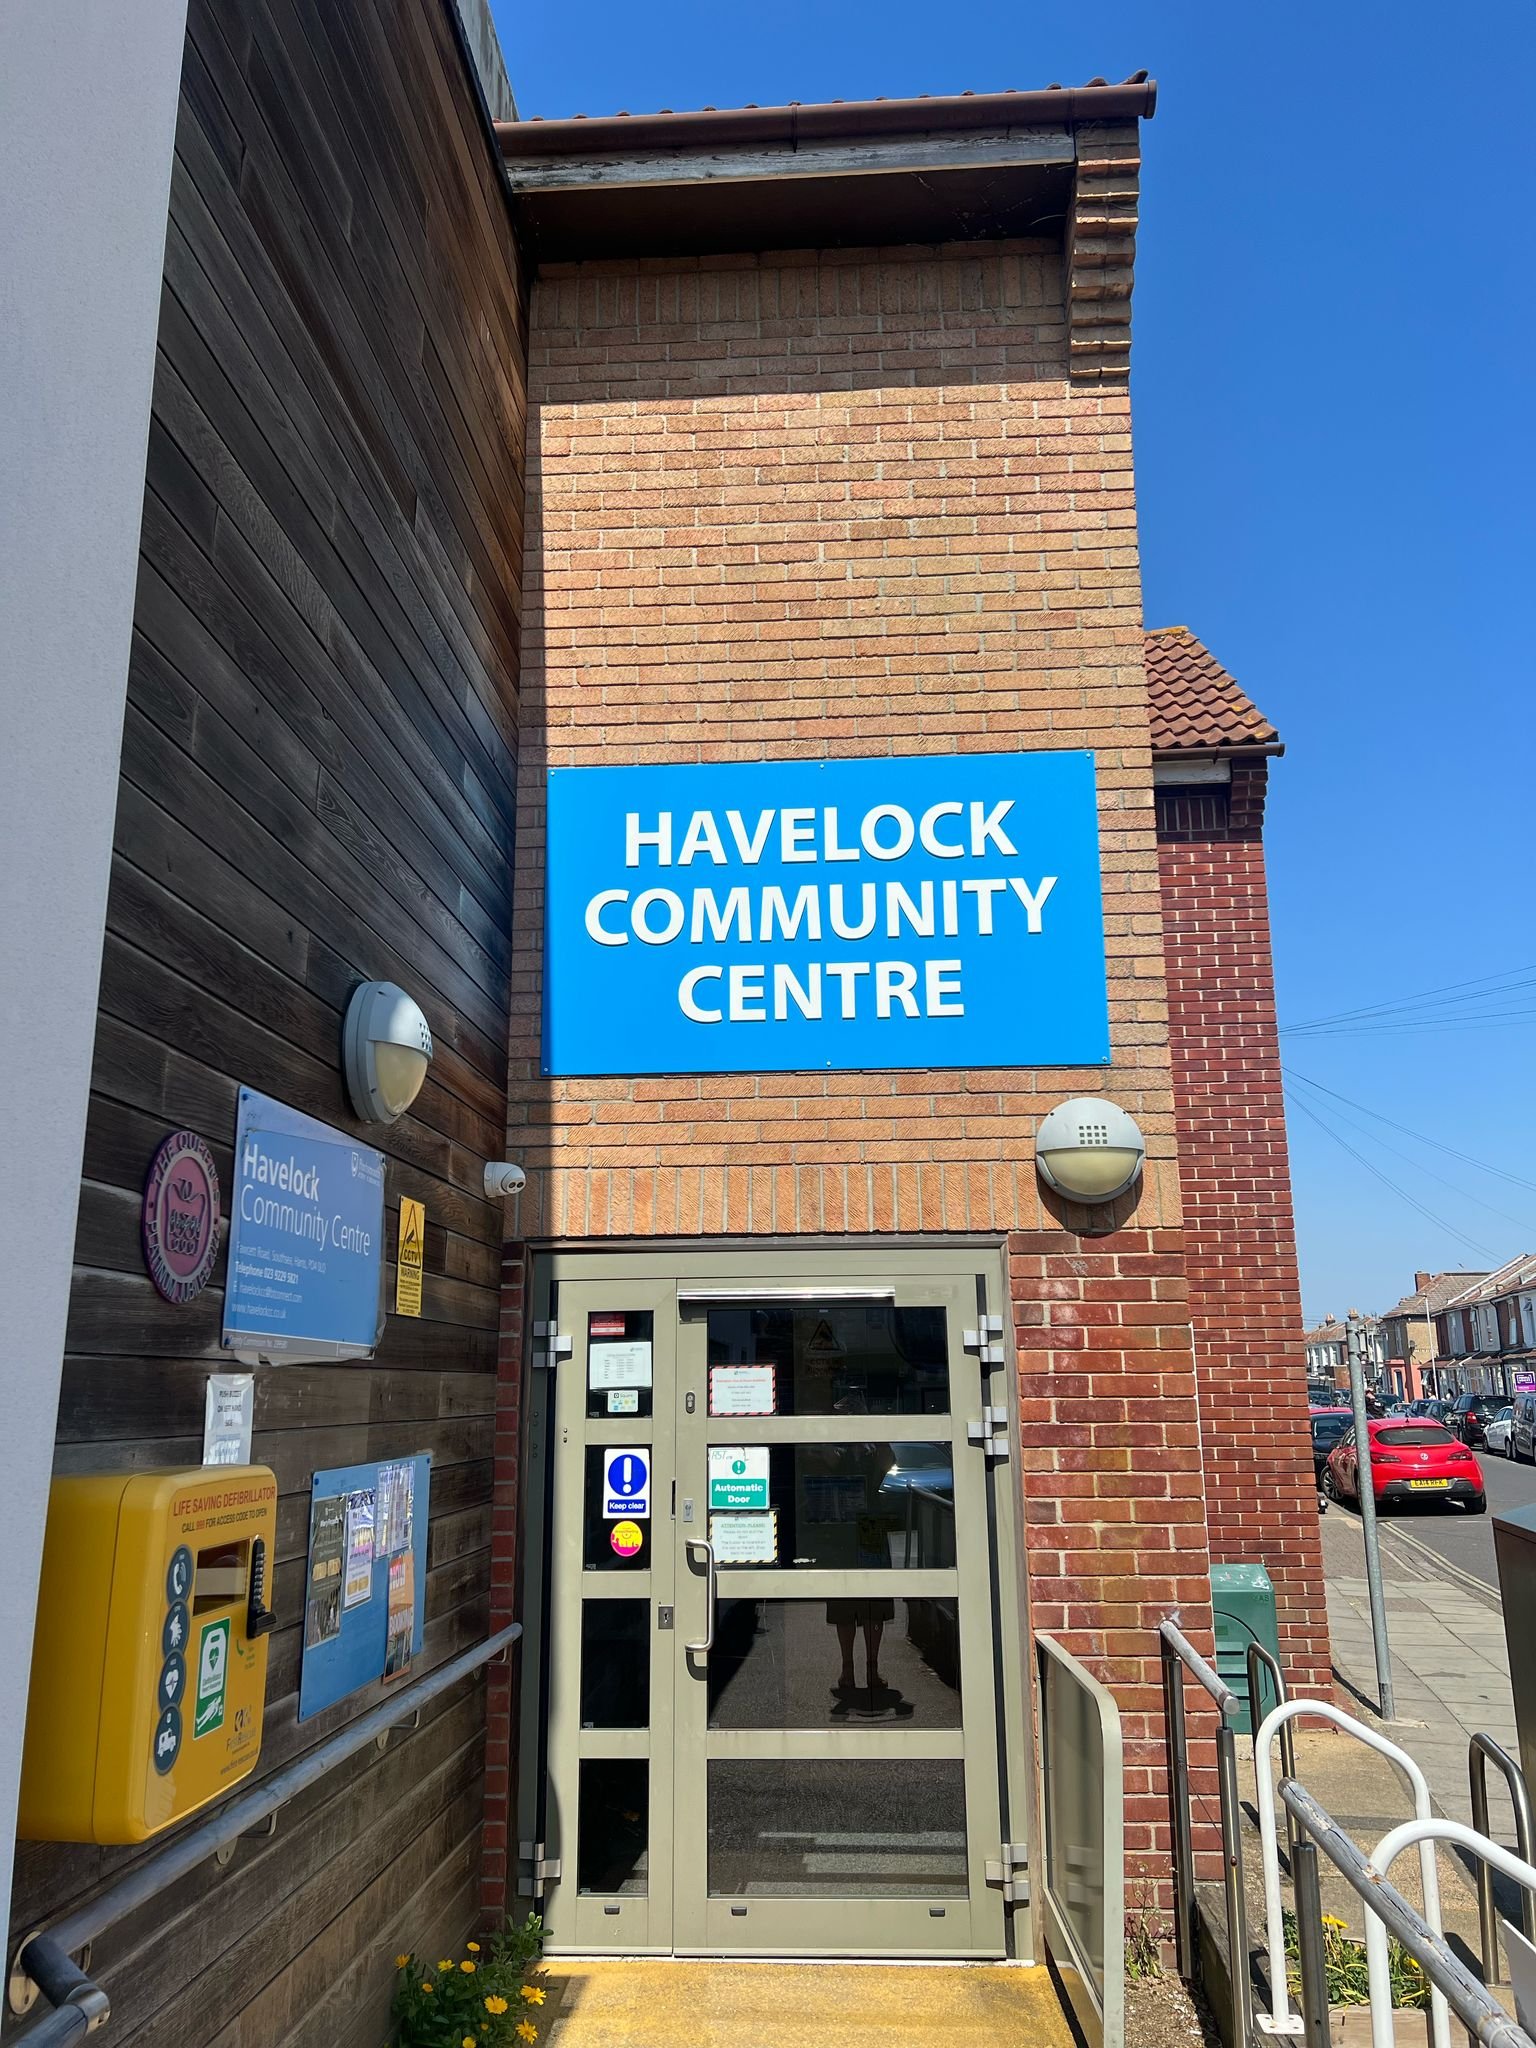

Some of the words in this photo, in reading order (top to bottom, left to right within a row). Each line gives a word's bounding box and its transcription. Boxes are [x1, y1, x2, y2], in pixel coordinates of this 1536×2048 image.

[624, 800, 1018, 867] HAVELOCK
[584, 876, 1058, 945] COMMUNITY
[677, 959, 965, 1023] CENTRE
[242, 1143, 320, 1202] Havelock
[240, 1184, 328, 1251] Community
[331, 1215, 371, 1257] Centre
[235, 1260, 263, 1279] Telephone
[403, 1248, 418, 1263] CCTV
[173, 1499, 193, 1516] LIFE
[192, 1494, 222, 1513] SAVING
[223, 1486, 276, 1508] DEFIBRILLATOR
[714, 1483, 764, 1492] Automatic
[727, 1495, 751, 1504] Door
[181, 1522, 196, 1533] CALL
[205, 1517, 216, 1528] FOR
[216, 1513, 236, 1526] ACCESS
[236, 1510, 249, 1522] CODE
[249, 1509, 256, 1519] TO
[255, 1507, 268, 1519] OPEN
[609, 1502, 627, 1511] Keep
[627, 1502, 645, 1510] clear
